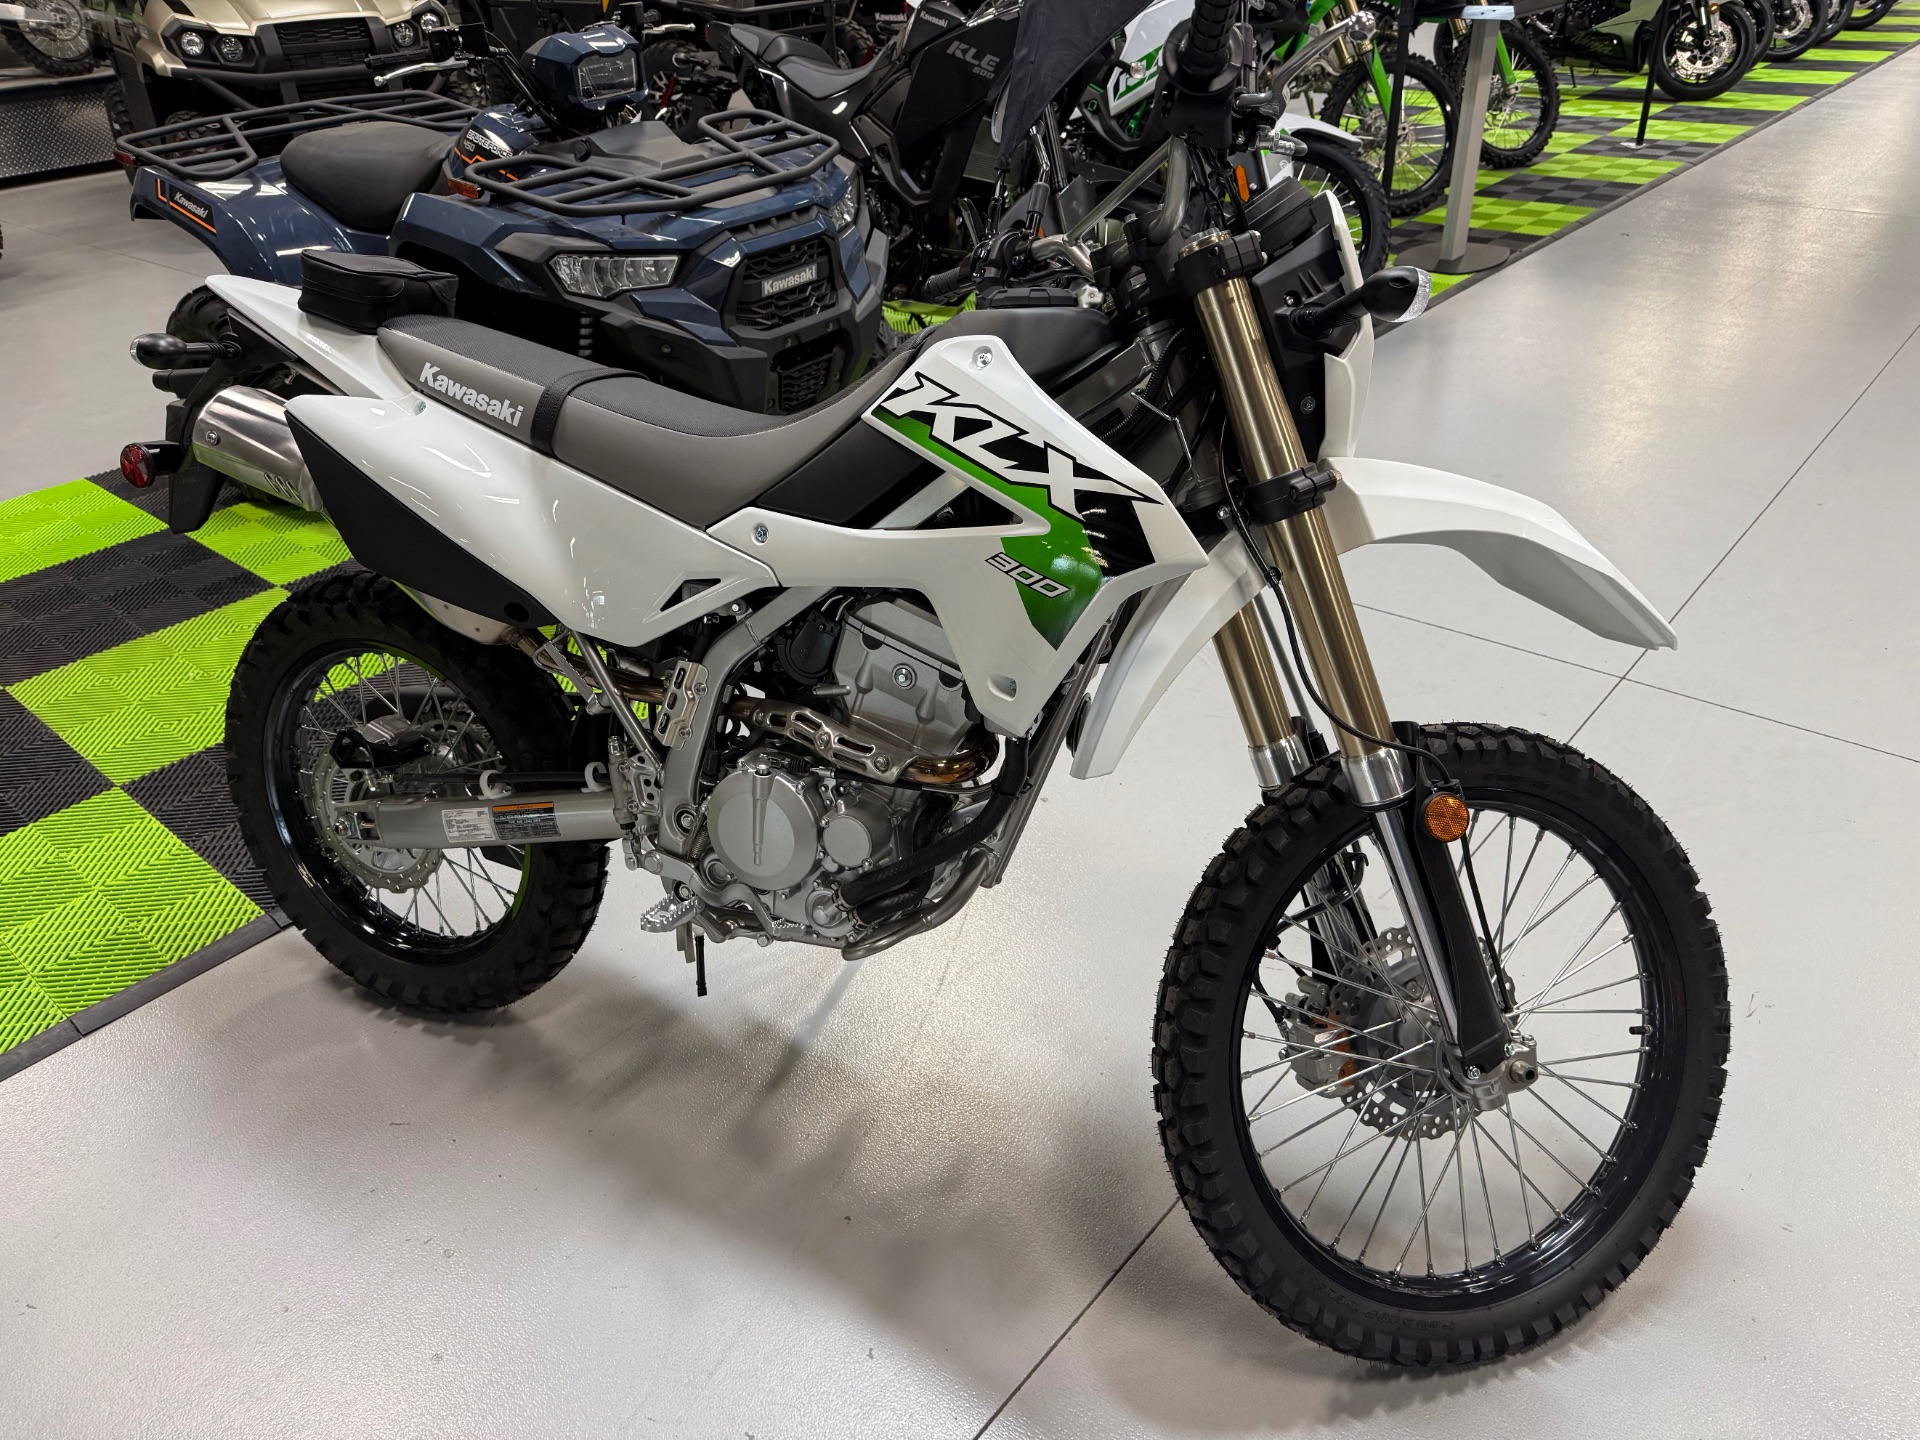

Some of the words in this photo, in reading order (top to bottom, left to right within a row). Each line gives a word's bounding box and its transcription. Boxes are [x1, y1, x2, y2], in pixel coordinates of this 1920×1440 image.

[875, 12, 907, 22] Kawasaki
[920, 10, 949, 28] Kawasaki
[946, 40, 1000, 72] KLE
[972, 66, 995, 80] 500
[463, 139, 476, 152] 450
[174, 191, 209, 218] Kawasaki
[764, 265, 816, 295] Kawasaki
[419, 362, 524, 427] Kawasaki
[880, 371, 1164, 523] KLX
[985, 551, 1071, 598] 300
